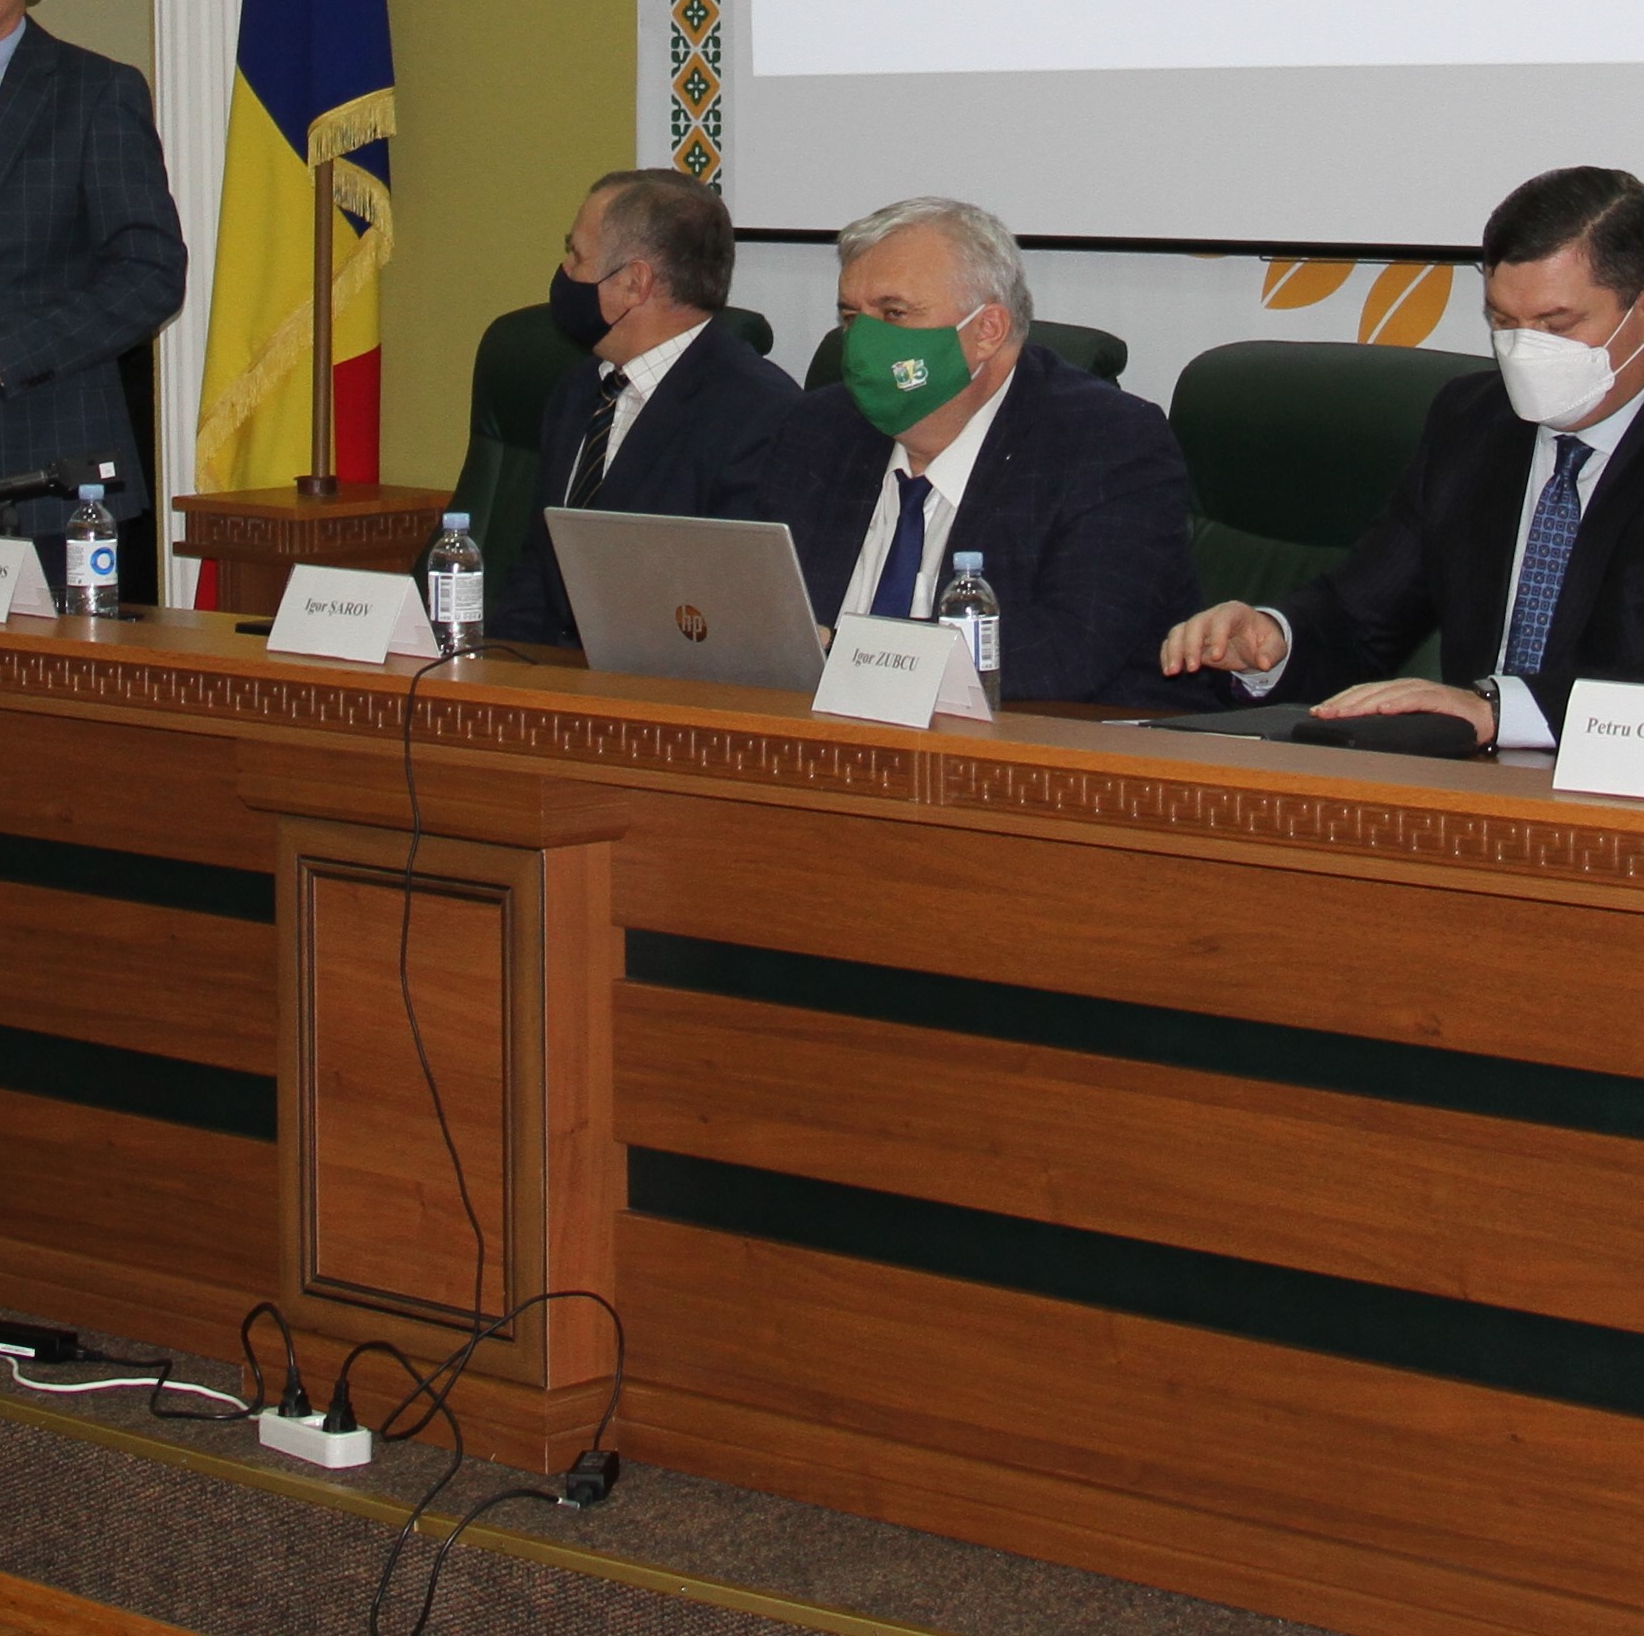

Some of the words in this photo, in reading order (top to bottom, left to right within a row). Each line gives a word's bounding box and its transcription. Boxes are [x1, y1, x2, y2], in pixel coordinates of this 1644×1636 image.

[305, 597, 327, 615] Igor
[852, 648, 875, 666] Igor
[876, 650, 920, 671] ZUBCU
[1586, 716, 1631, 737] Petru
